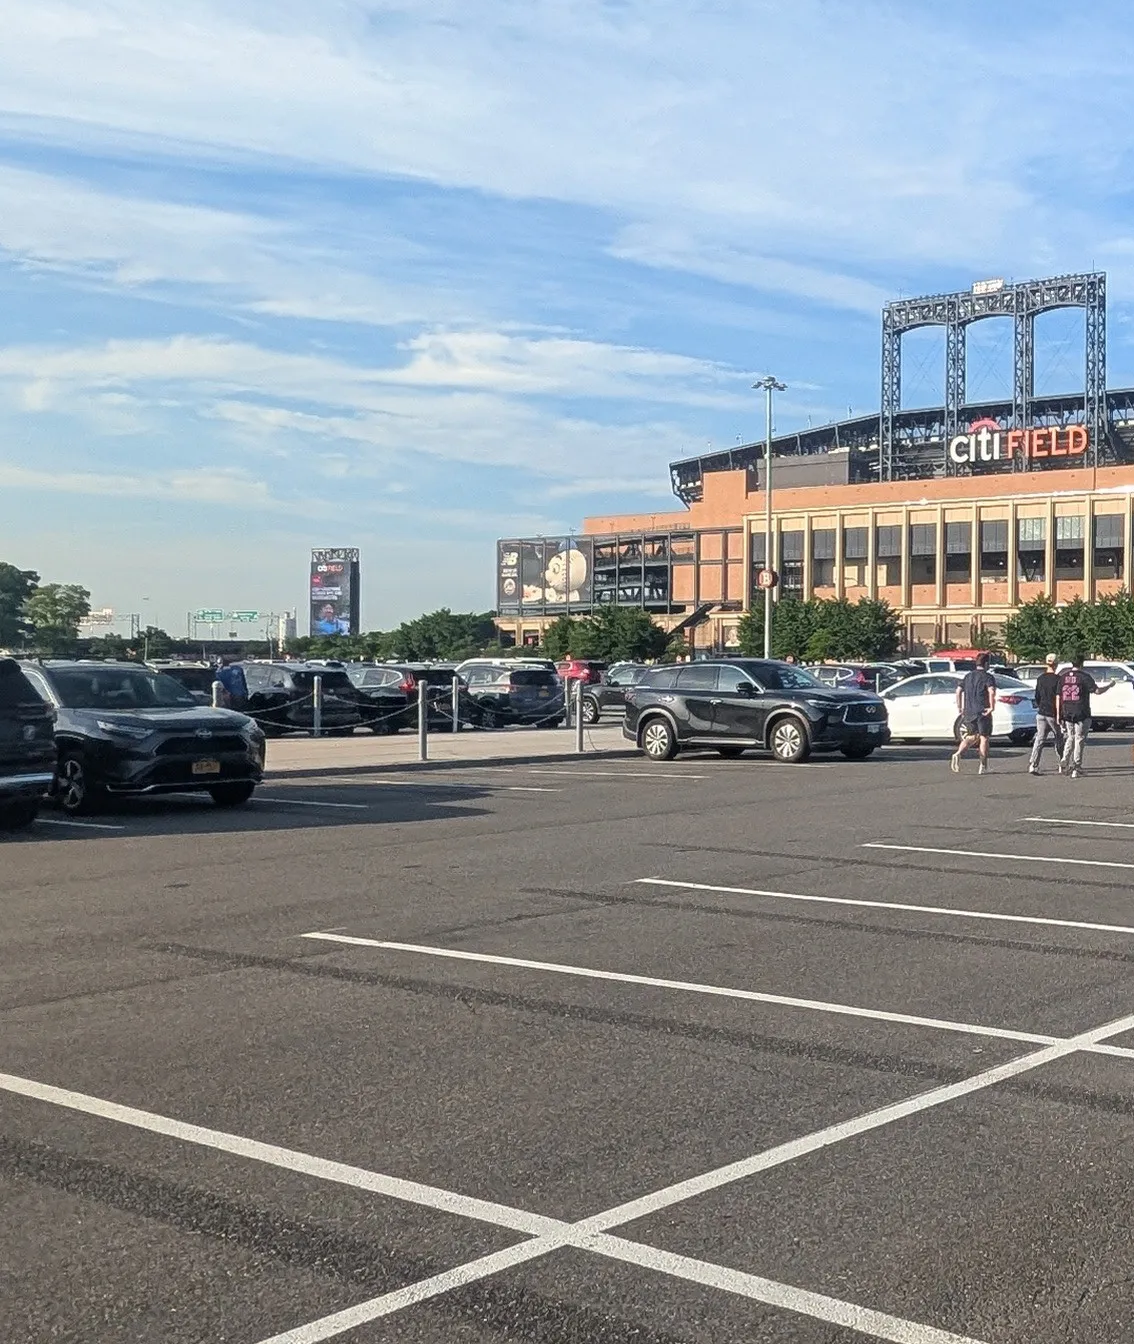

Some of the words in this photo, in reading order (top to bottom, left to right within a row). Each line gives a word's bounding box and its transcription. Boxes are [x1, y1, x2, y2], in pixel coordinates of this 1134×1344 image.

[950, 427, 1000, 463] citi
[1007, 425, 1088, 459] FIELD
[760, 572, 772, 586] B
